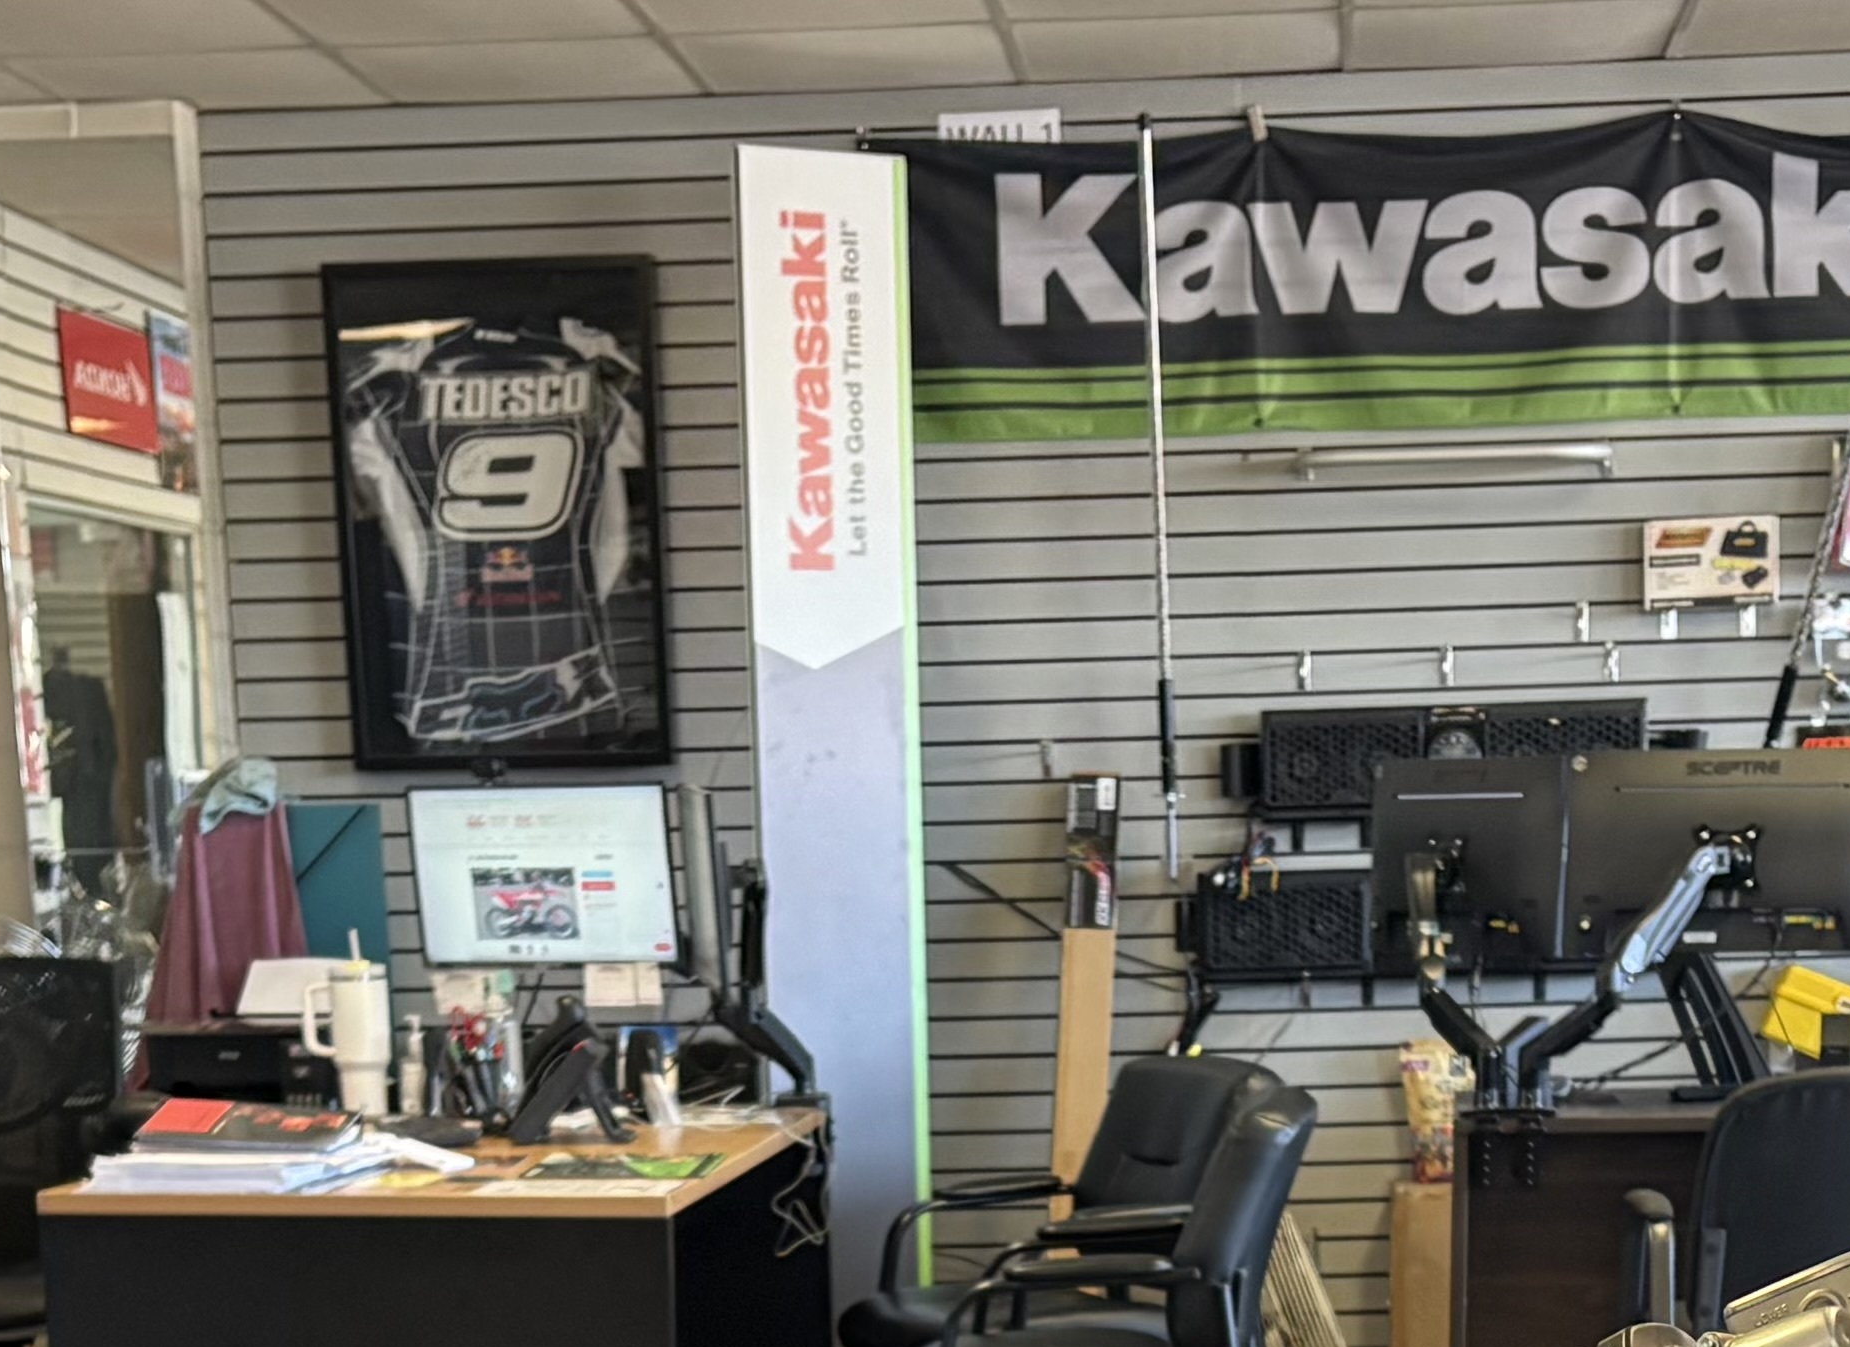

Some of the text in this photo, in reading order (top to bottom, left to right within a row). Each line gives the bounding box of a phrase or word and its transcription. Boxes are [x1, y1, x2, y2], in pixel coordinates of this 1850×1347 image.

[842, 291, 862, 375] Times
[420, 371, 591, 421] TEDESCO
[779, 210, 835, 571] Kawasaki
[844, 379, 864, 455] Good
[435, 428, 584, 540] 9
[847, 460, 866, 505] the
[849, 514, 868, 558] Let
[1686, 760, 1781, 776] SCEPTRE
